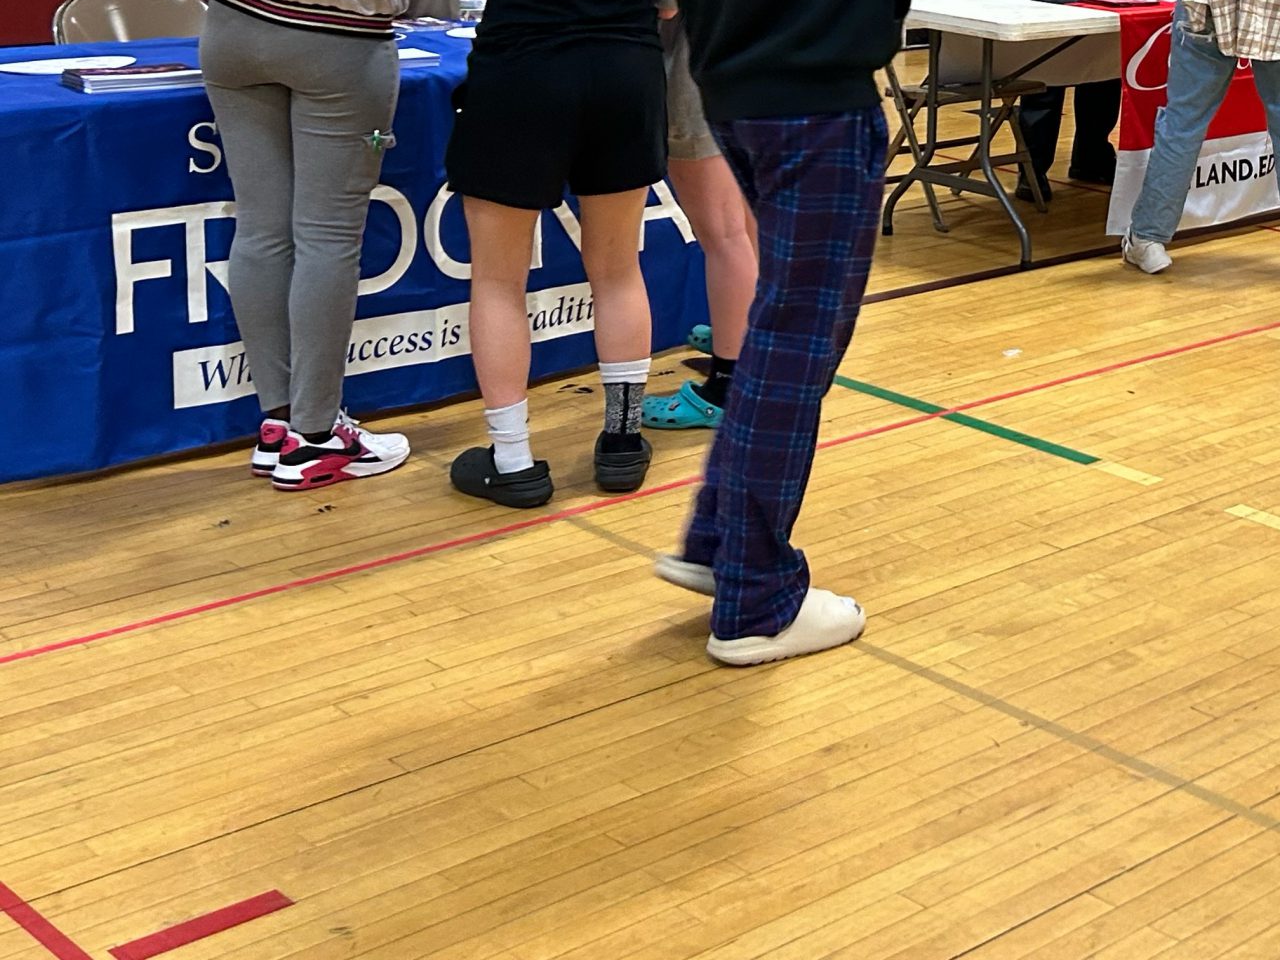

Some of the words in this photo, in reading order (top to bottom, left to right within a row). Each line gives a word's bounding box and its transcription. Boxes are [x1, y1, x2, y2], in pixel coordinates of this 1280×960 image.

[1194, 153, 1276, 189] LAND.ED
[341, 331, 433, 364] uccess
[440, 319, 462, 348] is
